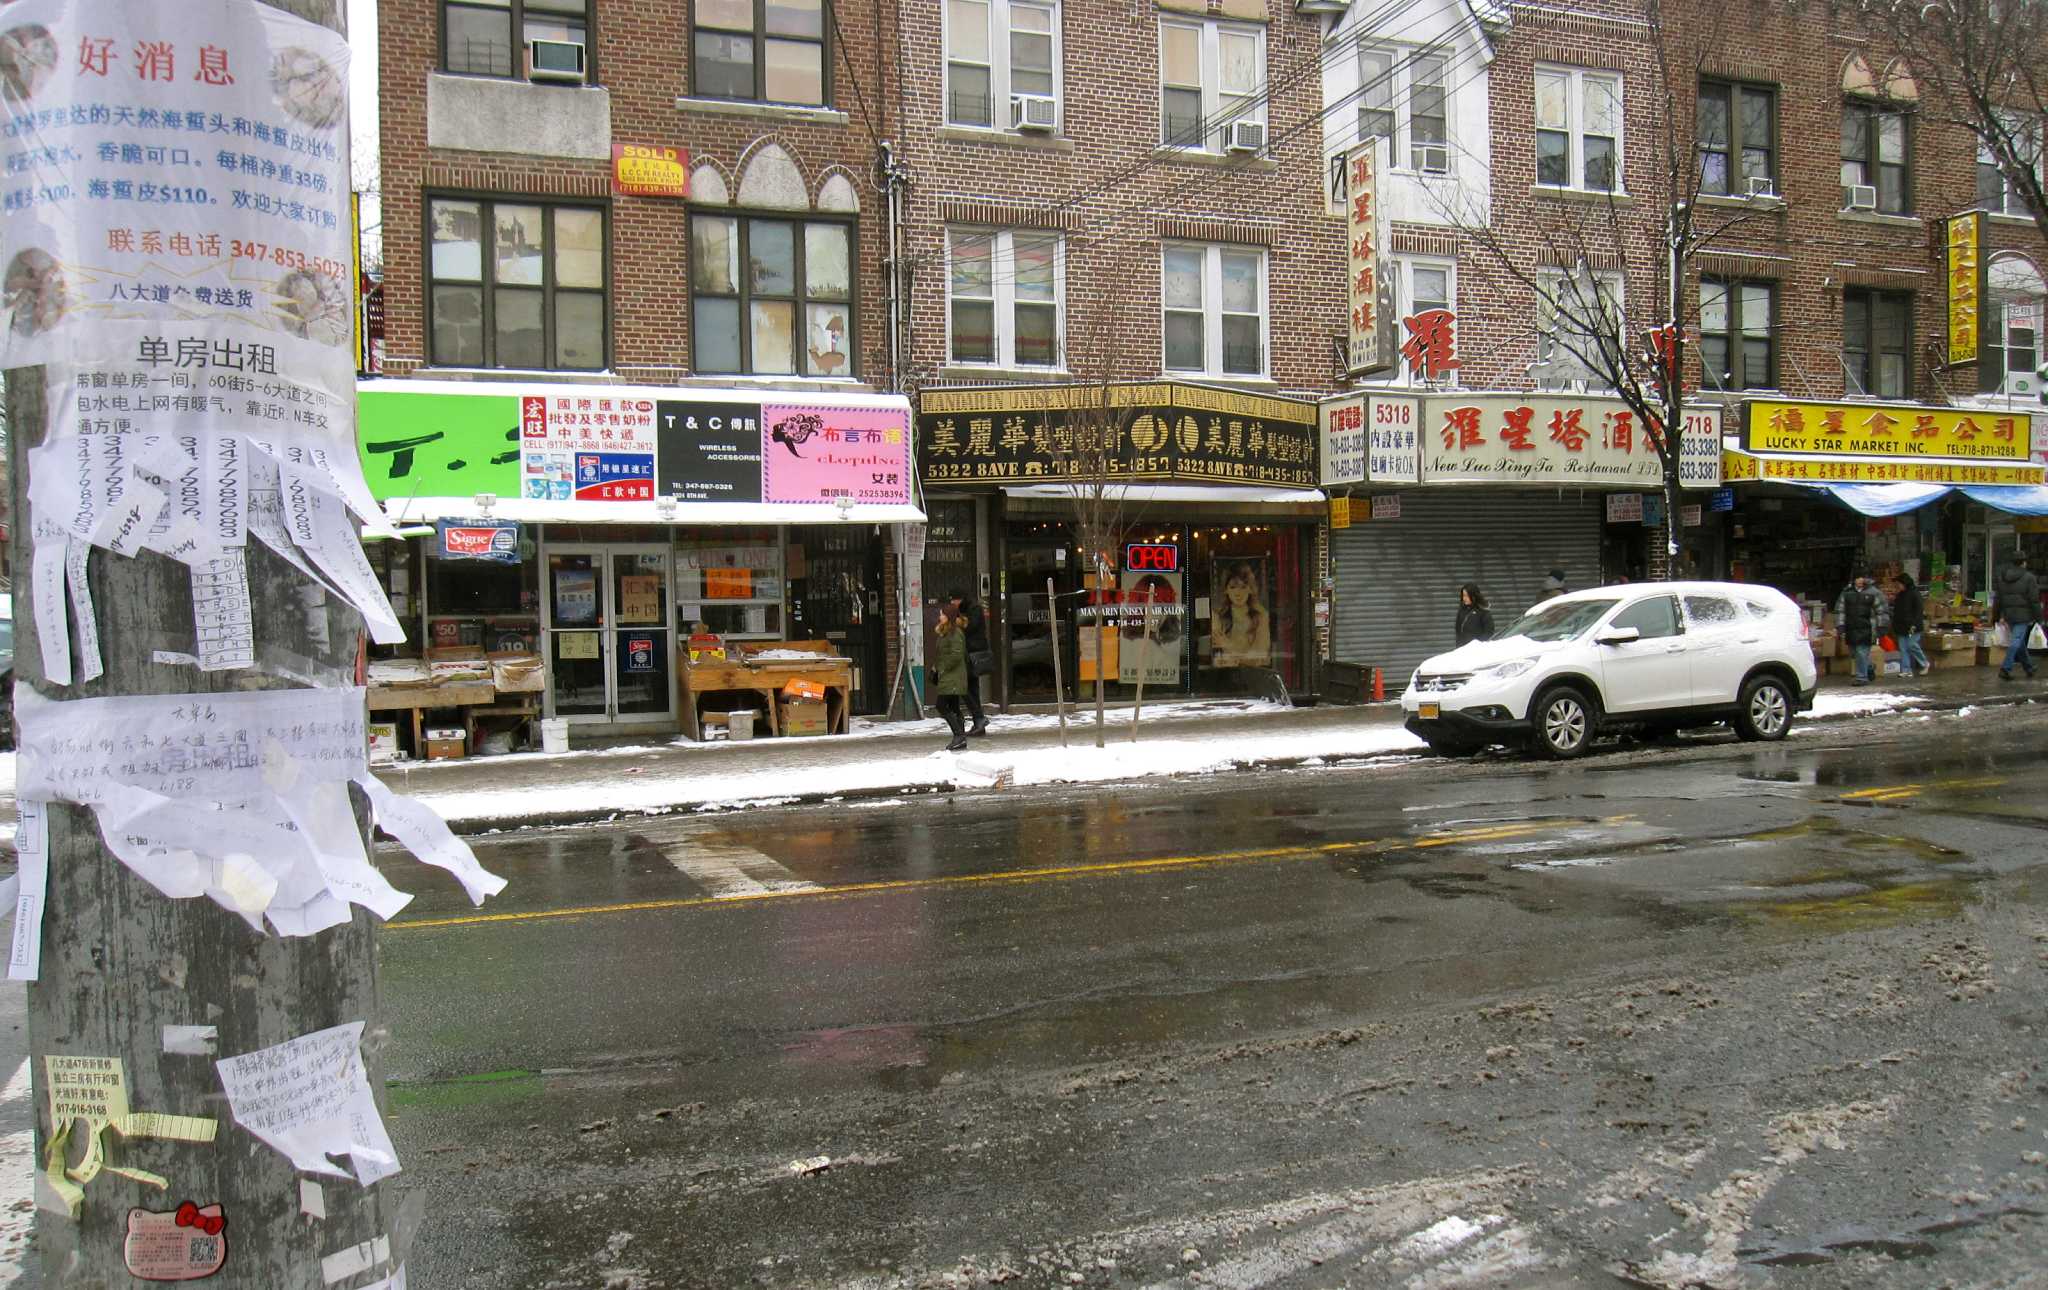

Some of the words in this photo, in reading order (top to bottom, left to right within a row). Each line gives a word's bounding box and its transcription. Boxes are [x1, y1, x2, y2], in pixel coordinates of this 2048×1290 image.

[77, 36, 235, 86] 好消息
[623, 145, 677, 161] SOLD
[108, 228, 221, 258] 联系电话
[137, 335, 278, 376] 单房出租
[524, 399, 545, 435] 宏旺
[665, 415, 677, 430] T
[686, 416, 699, 430] &
[708, 417, 723, 431] C
[1376, 403, 1411, 425] 5318
[1686, 415, 1713, 435] 718
[1768, 406, 2016, 443] 福星食品公司
[1766, 436, 1807, 449] LUCKY
[1814, 438, 1843, 450] STAR
[1850, 440, 1899, 453] MARKET
[1905, 442, 1928, 454] INC.
[928, 463, 973, 478] 5322
[977, 461, 1019, 477] 8AVE
[1177, 458, 1205, 473] 5322
[1425, 456, 1458, 473] New
[1461, 456, 1491, 473] Luo
[1494, 456, 1533, 478] Xing
[1535, 458, 1554, 473] Ta
[1563, 459, 1633, 475] Restaurant
[1680, 461, 1718, 480] 633-3387
[602, 486, 650, 498] 汇款中国
[449, 530, 488, 547] Sigue
[1129, 546, 1176, 571] OPEN
[1080, 607, 1119, 617] MANARIN
